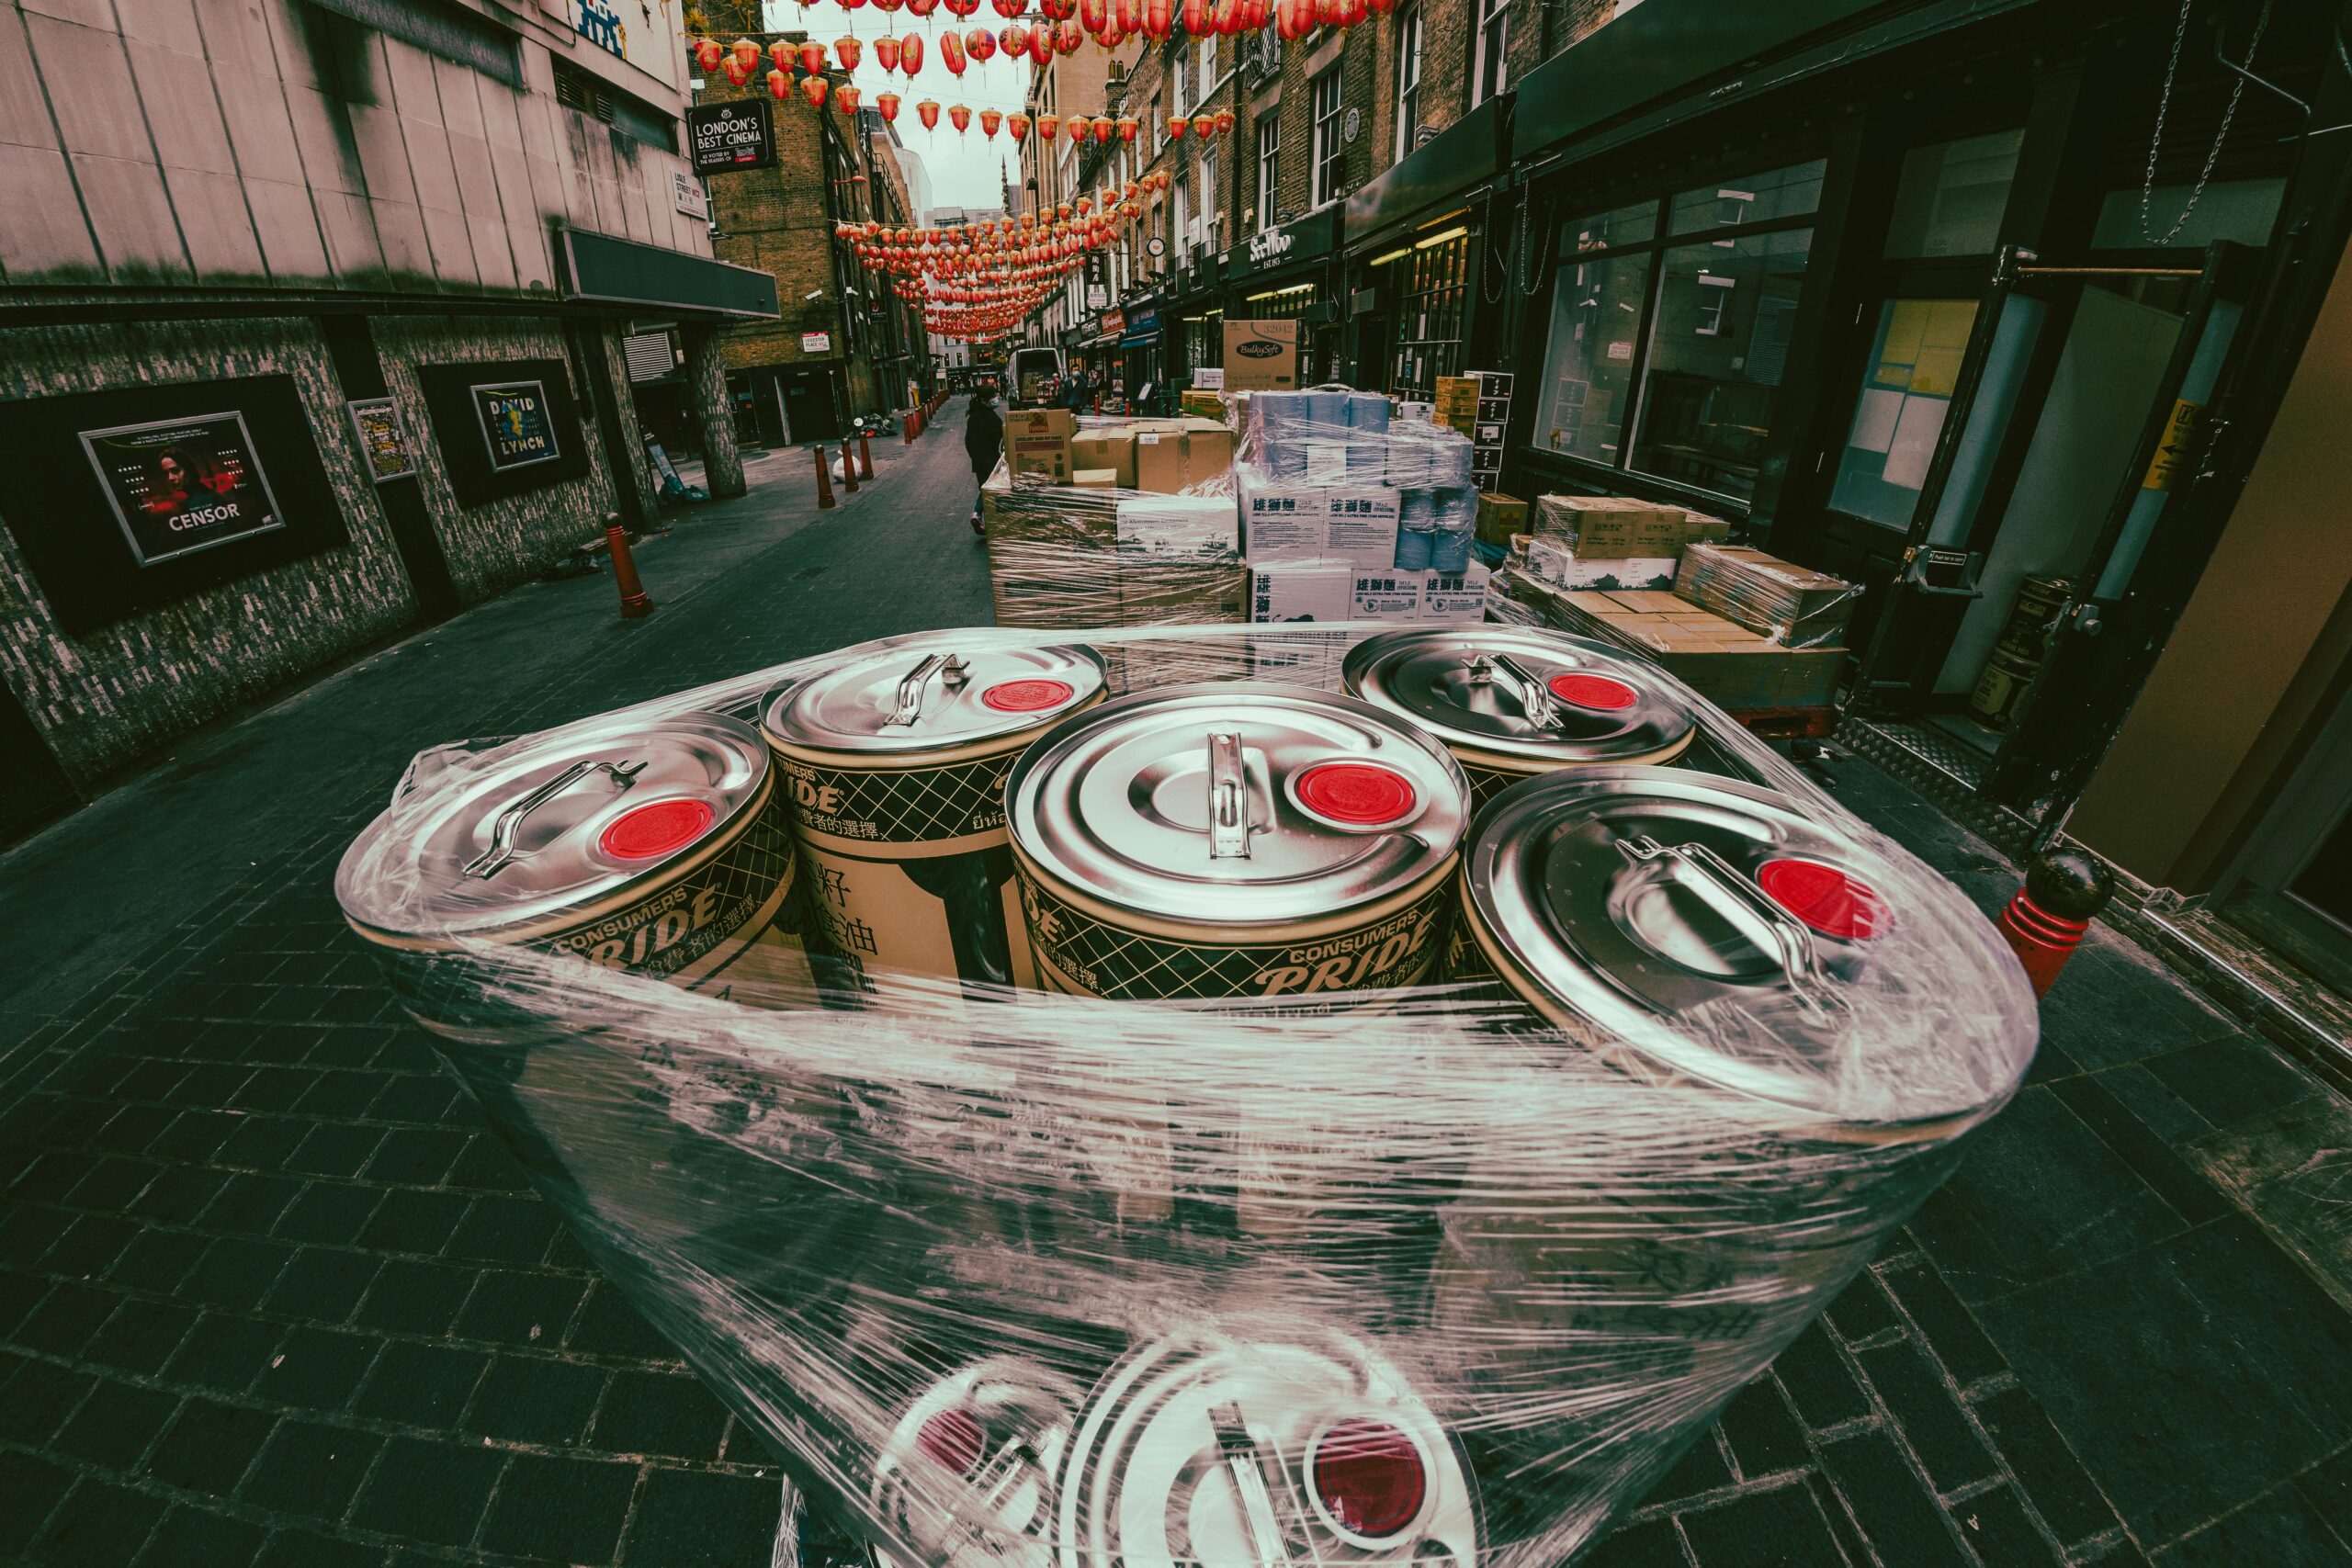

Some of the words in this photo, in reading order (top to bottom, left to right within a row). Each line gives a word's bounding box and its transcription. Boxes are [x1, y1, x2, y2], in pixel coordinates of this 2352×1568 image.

[696, 118, 758, 137] LONDON'S
[697, 135, 722, 150] BEST
[726, 131, 762, 145] CINEMA
[674, 172, 686, 184] LISLE
[676, 182, 691, 195] STREET
[692, 188, 700, 198] WC2
[1263, 323, 1293, 333] 32042
[1240, 344, 1280, 357] BulkySoft
[489, 398, 535, 415] DAVID
[501, 436, 545, 456] LYNCH
[1329, 499, 1373, 513] 雄獅麵
[169, 502, 241, 532] CENSOR
[1356, 578, 1396, 591] 雄獅麵
[1426, 578, 1464, 591] 雄獅麵
[797, 807, 878, 840] 費者的選擇
[555, 886, 687, 953] CONSUMER'S
[587, 883, 717, 970] RIDE
[1253, 908, 1436, 997] PRIDE
